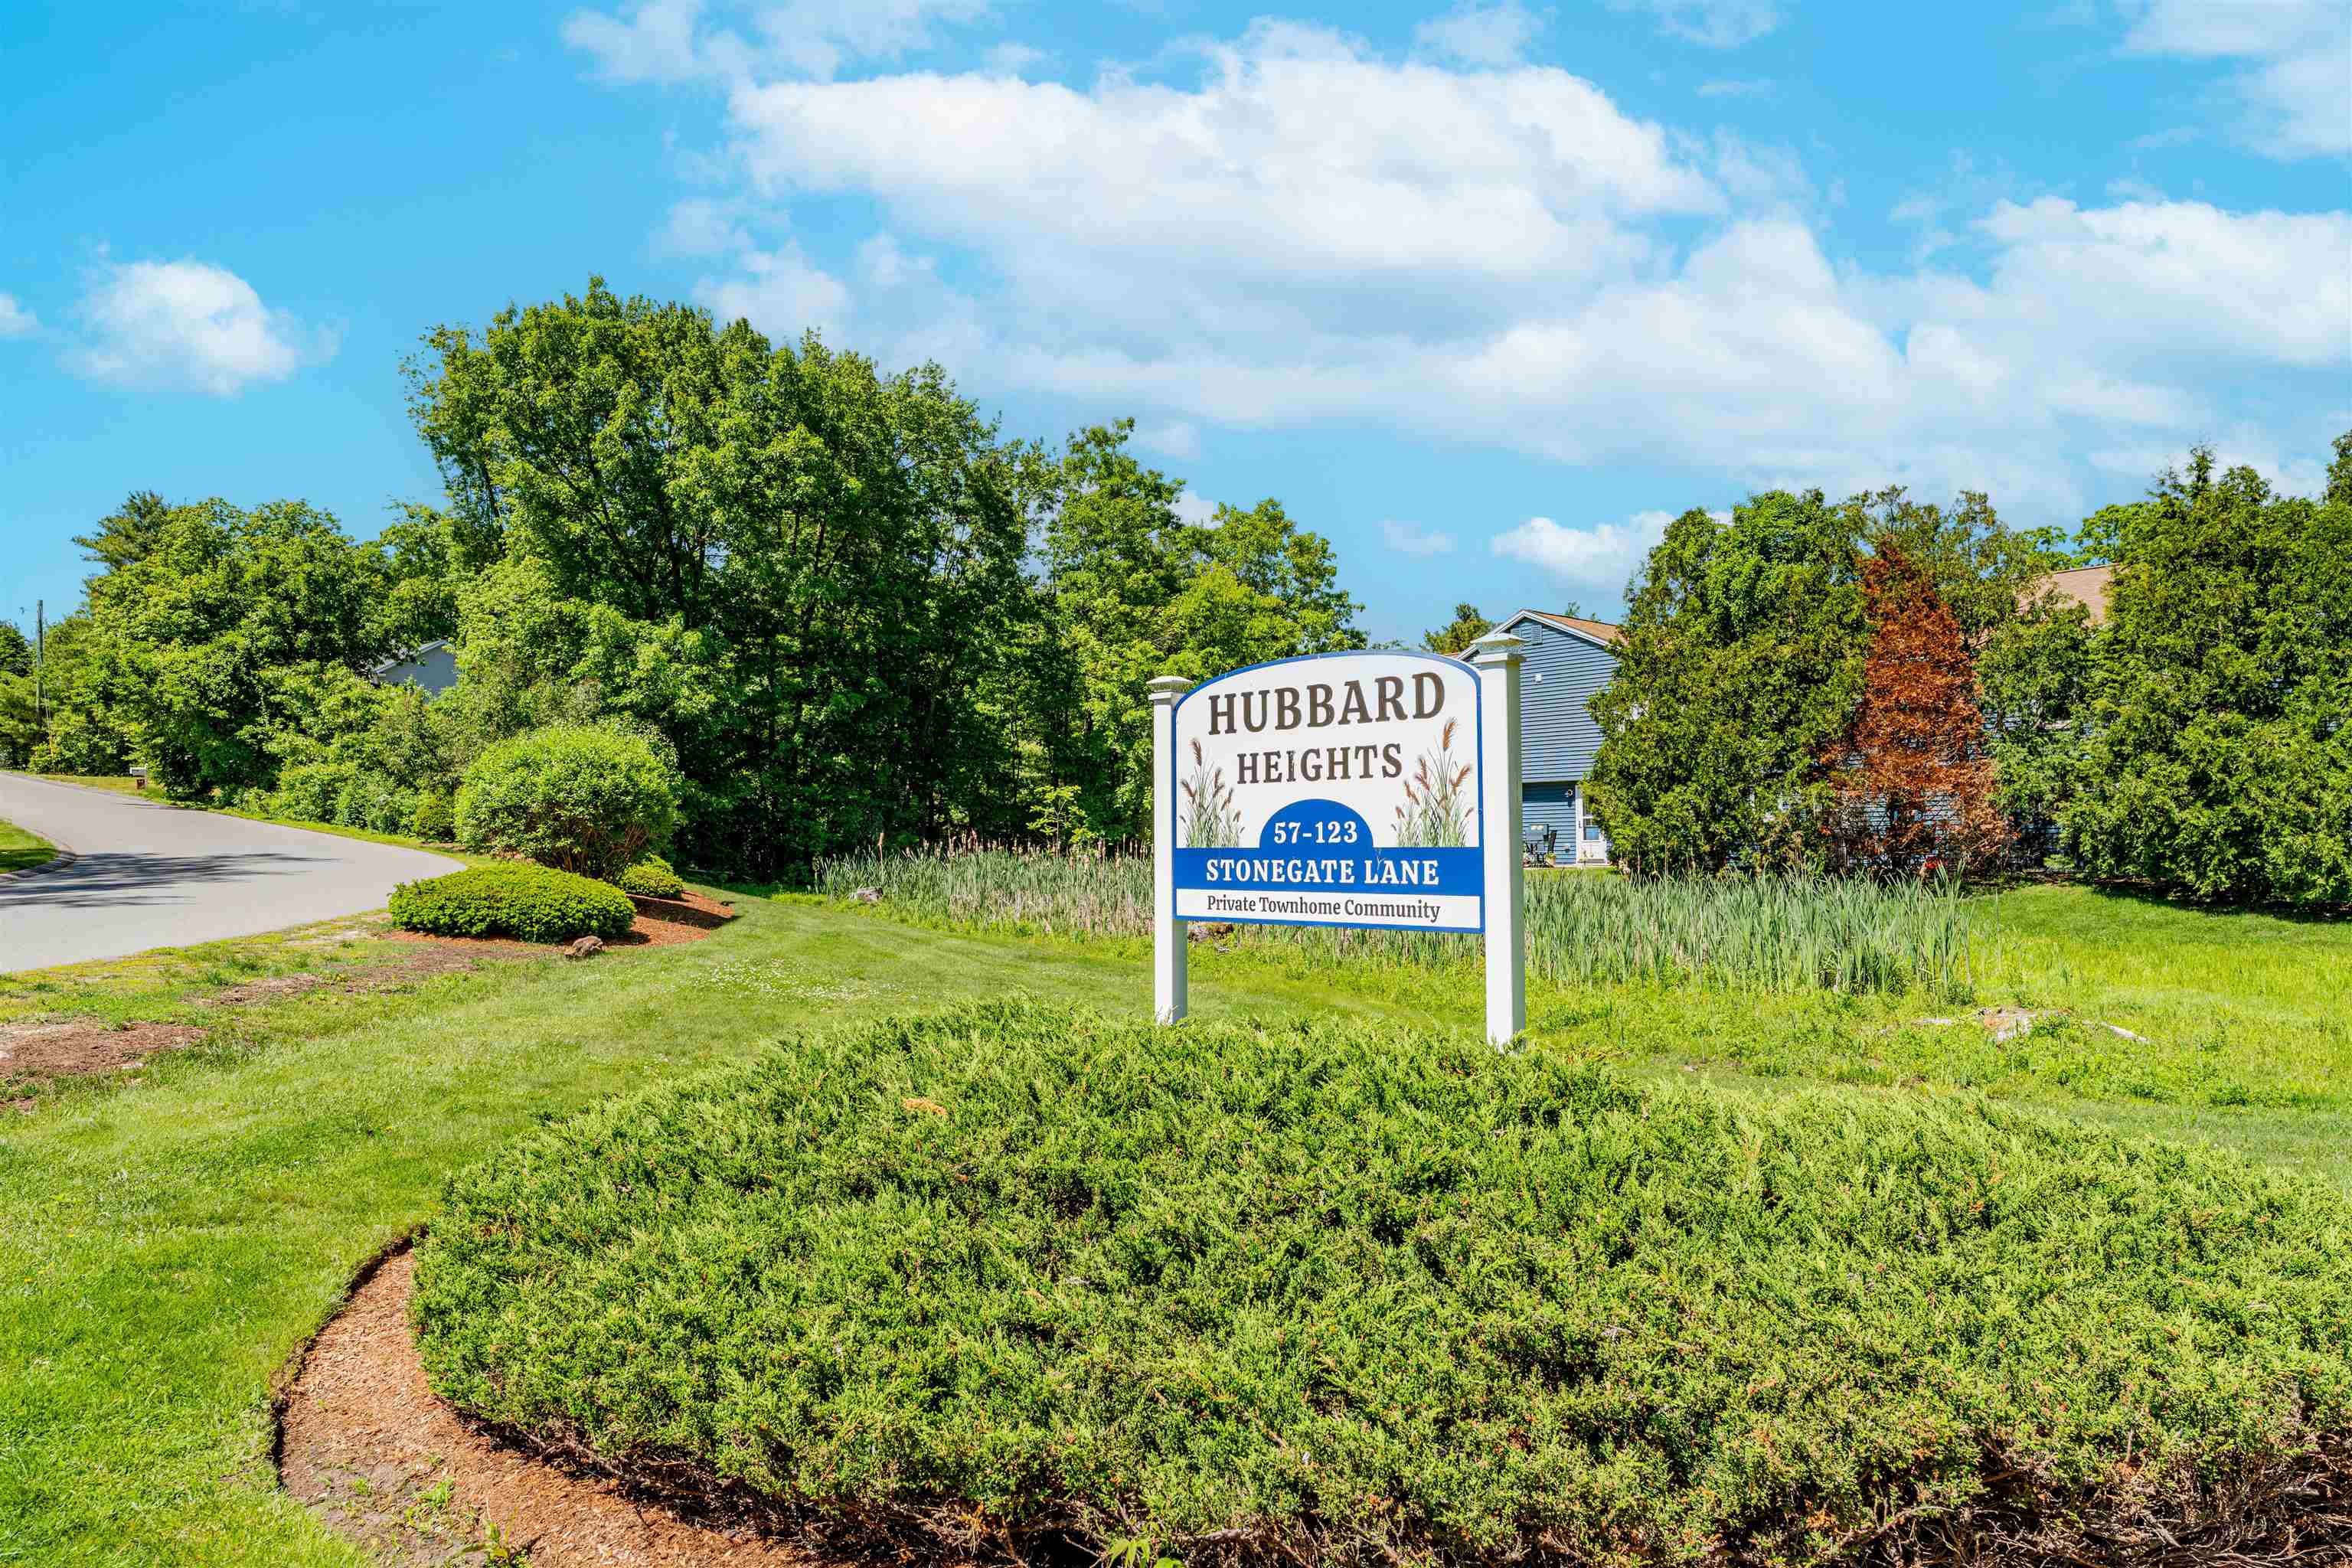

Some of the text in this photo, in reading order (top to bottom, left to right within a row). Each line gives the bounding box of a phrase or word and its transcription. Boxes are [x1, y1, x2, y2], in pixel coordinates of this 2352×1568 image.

[1208, 671, 1445, 736] HUBBARD
[1236, 743, 1402, 785] HEIGHTS
[1273, 821, 1357, 844] 57-123
[1206, 858, 1439, 886] STONEGATE LANE
[1207, 894, 1441, 923] Private Townhome Community
